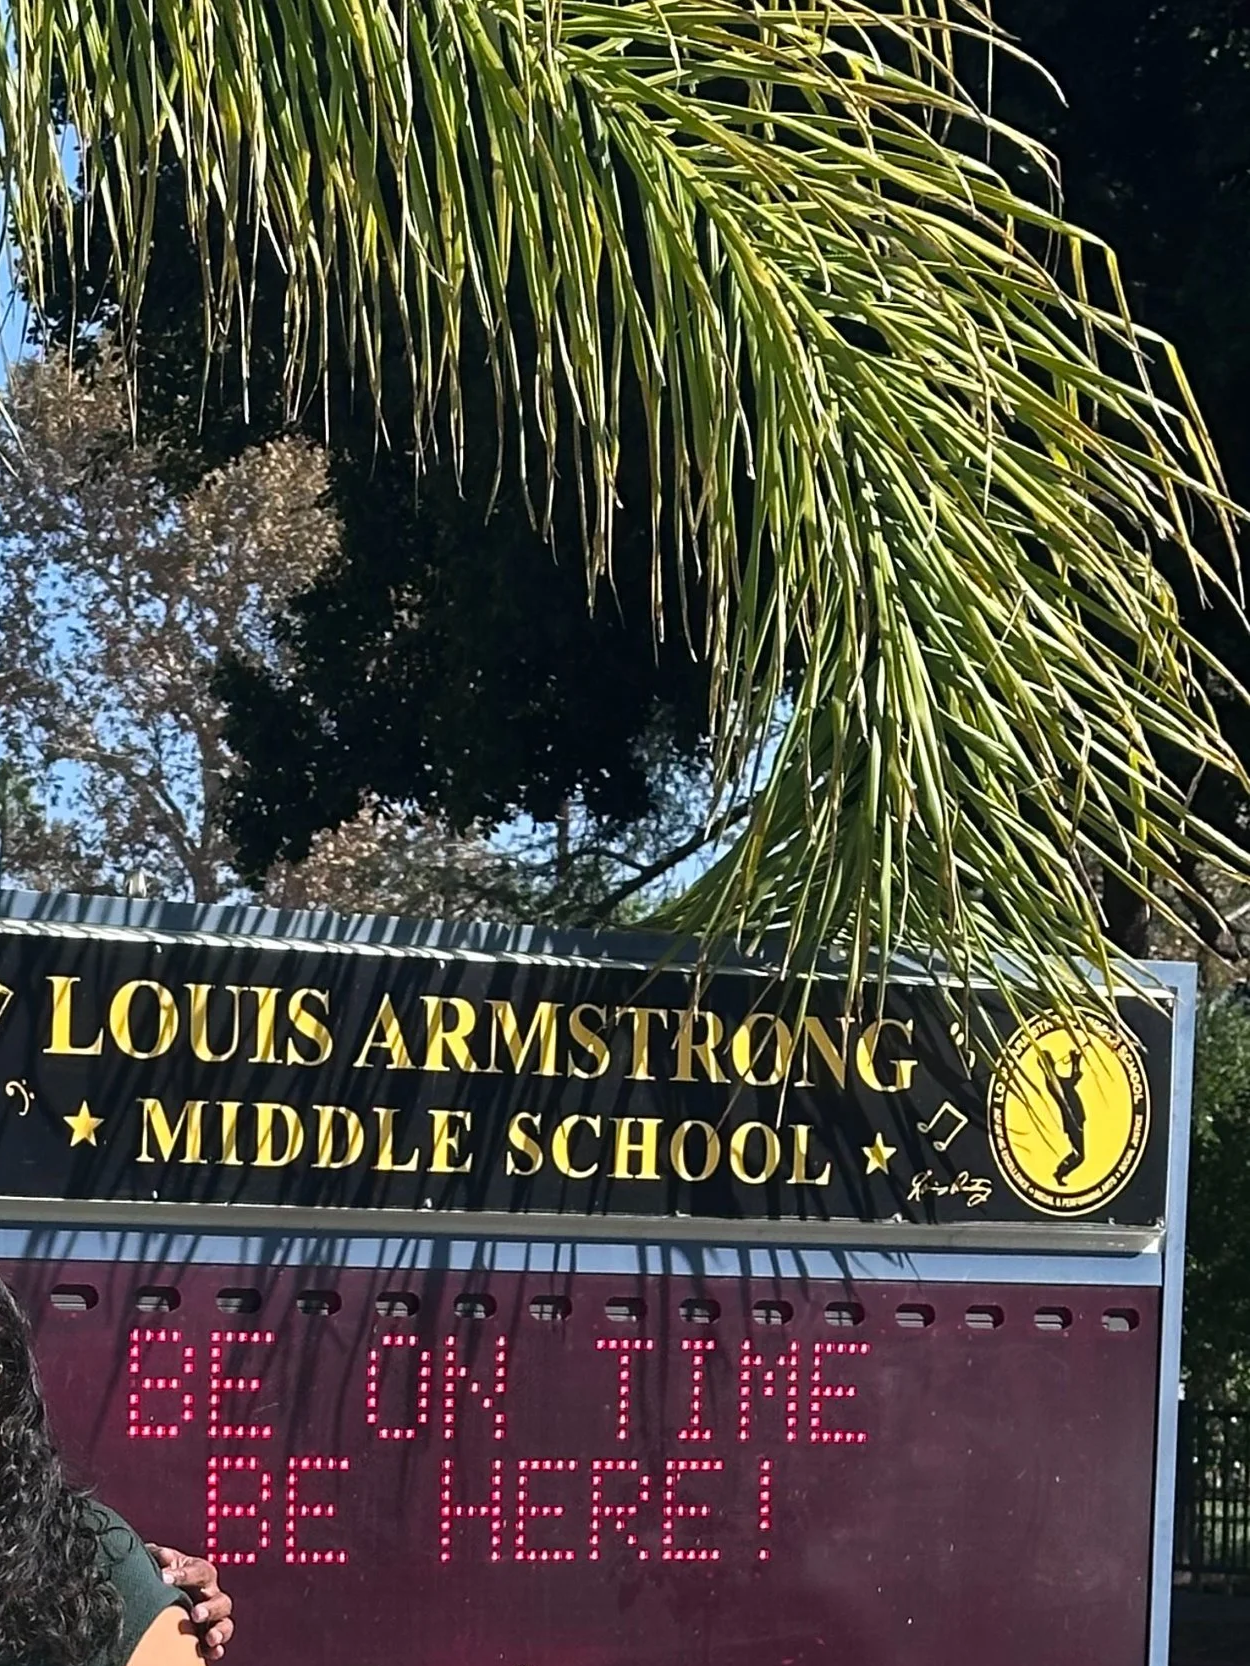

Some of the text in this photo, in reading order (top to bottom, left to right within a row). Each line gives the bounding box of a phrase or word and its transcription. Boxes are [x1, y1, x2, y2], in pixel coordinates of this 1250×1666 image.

[43, 975, 334, 1067] LOUIS
[353, 992, 919, 1093] ARMSTRONG
[136, 1097, 832, 1185] MIDDLE SCHOOL
[125, 1328, 871, 1444] BE ON TIME
[205, 1456, 773, 1565] BE HERE!
